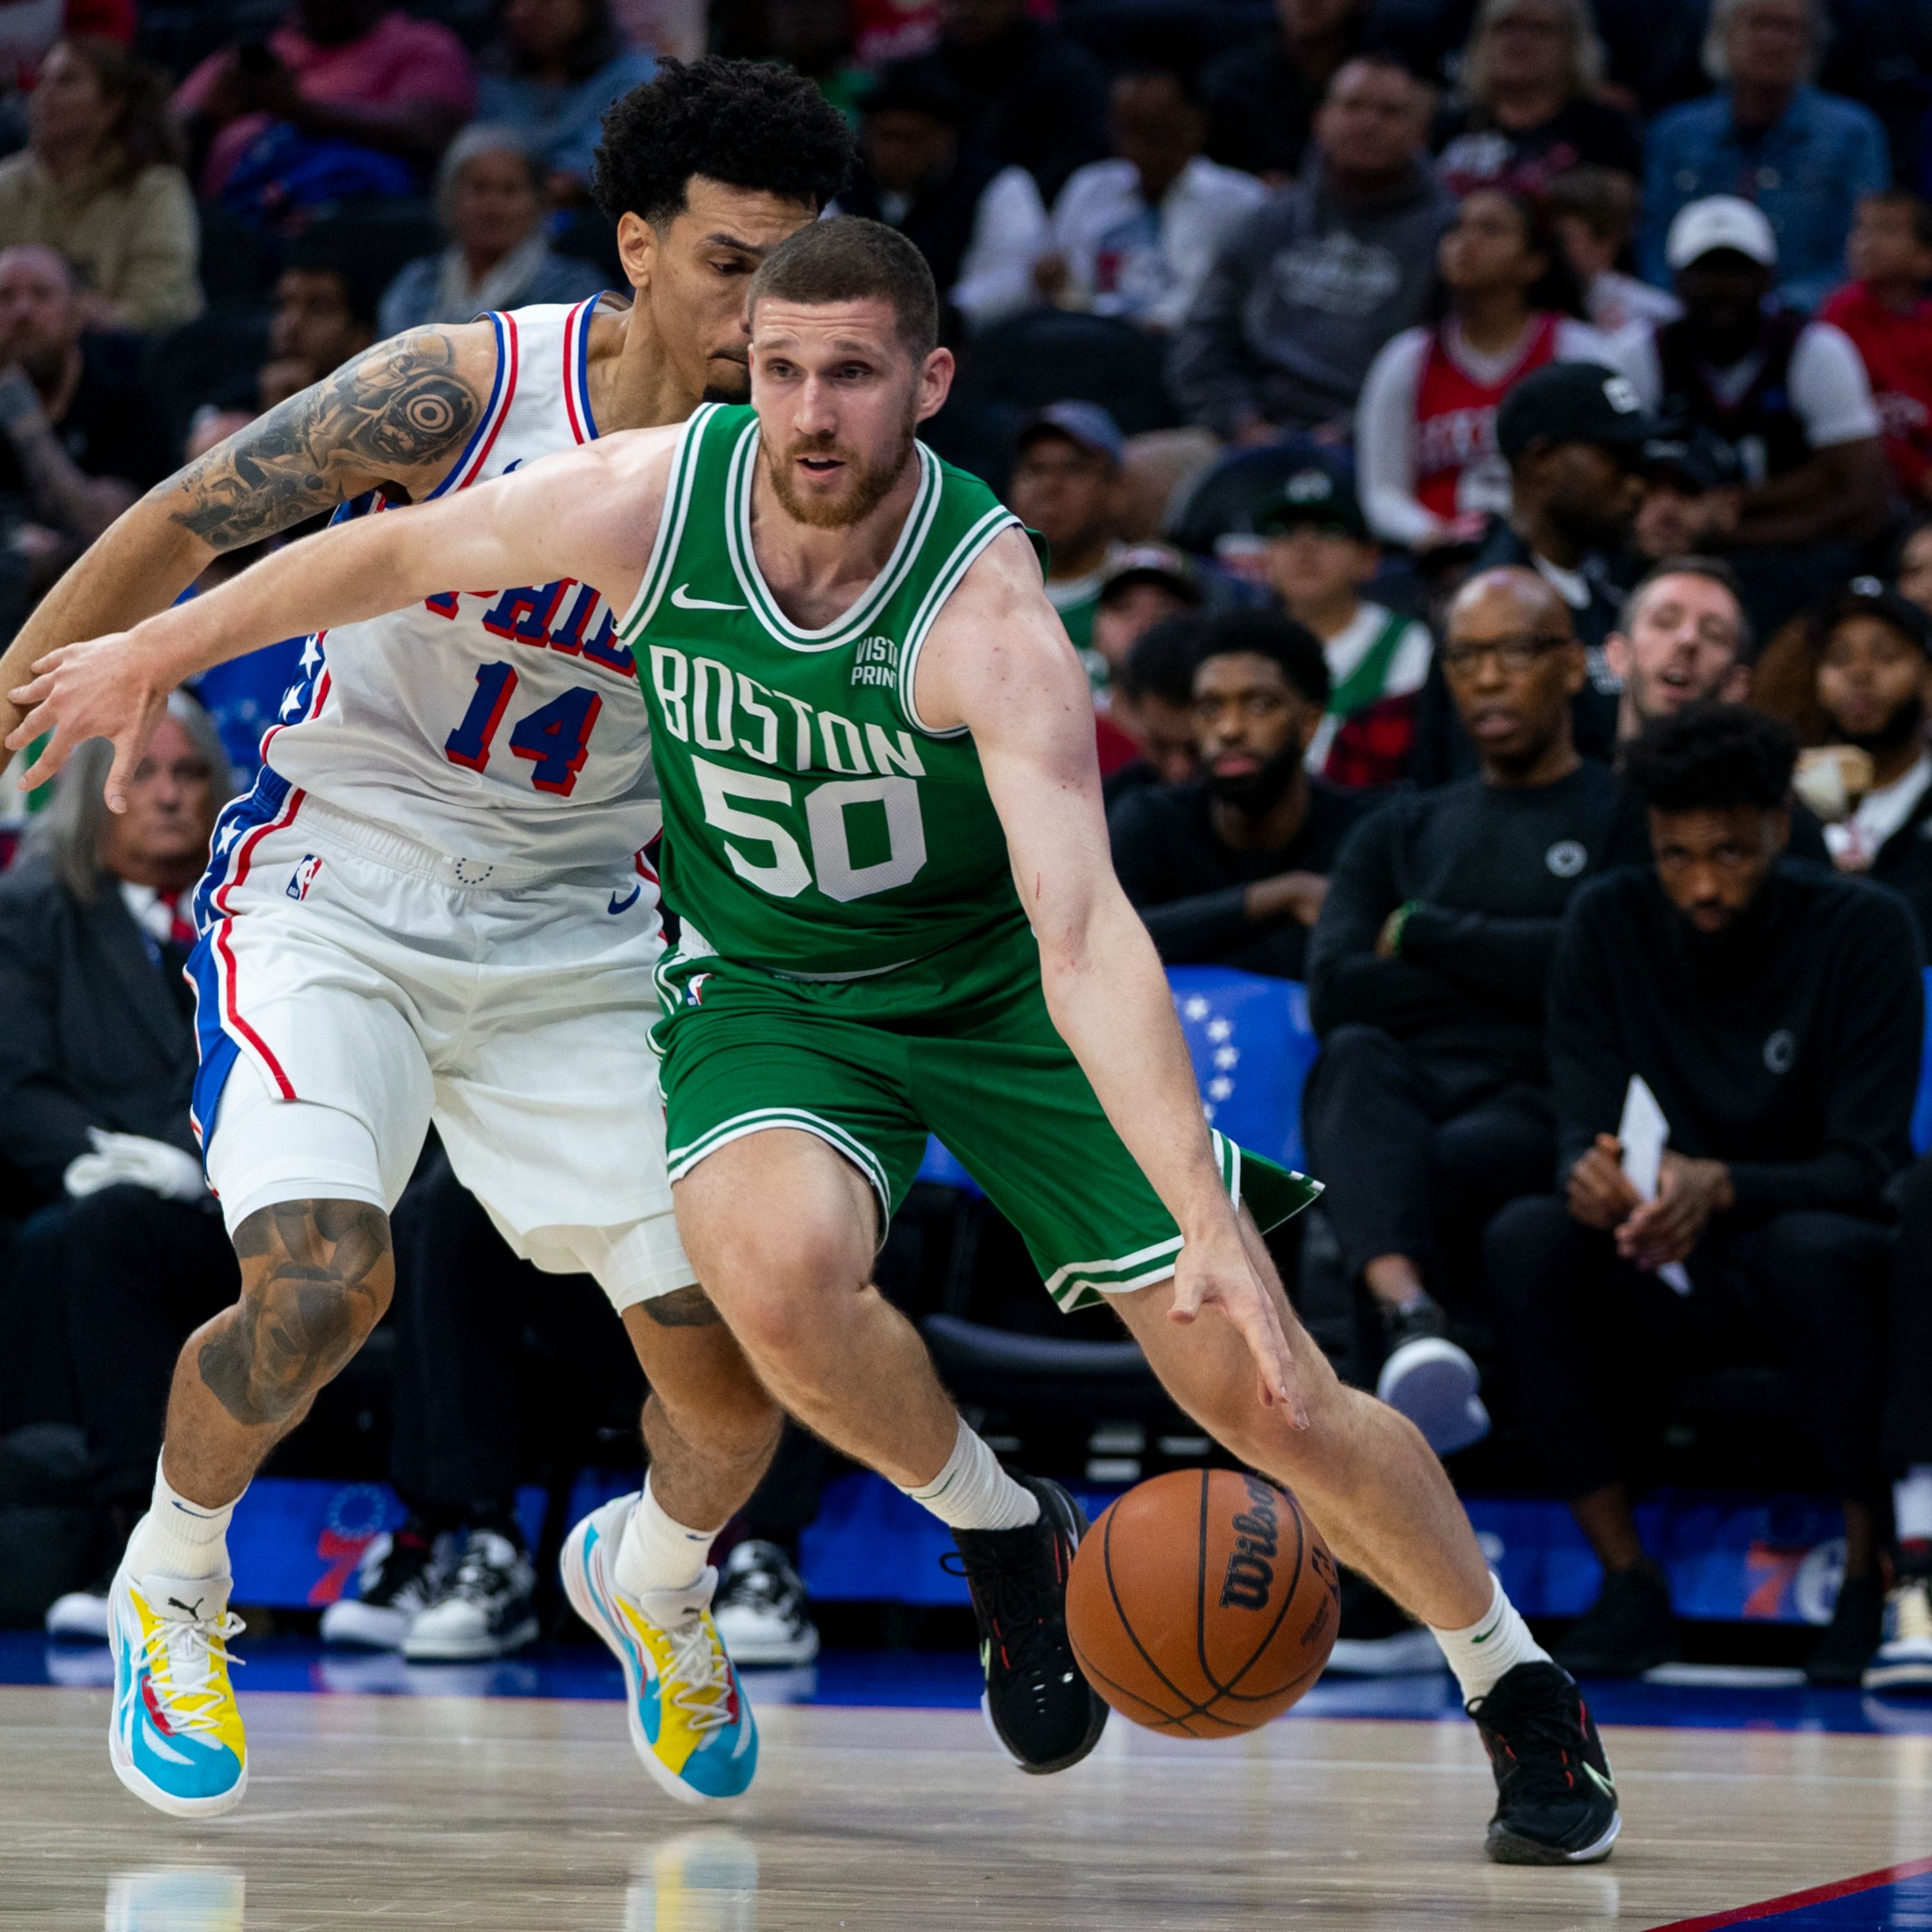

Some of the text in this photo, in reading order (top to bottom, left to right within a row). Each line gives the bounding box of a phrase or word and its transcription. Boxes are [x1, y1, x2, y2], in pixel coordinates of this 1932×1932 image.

[425, 577, 636, 678] HIL
[444, 660, 603, 797] 14
[649, 645, 927, 776] BOSTON
[690, 754, 927, 902] 50
[1219, 1473, 1278, 1611] Wilso
